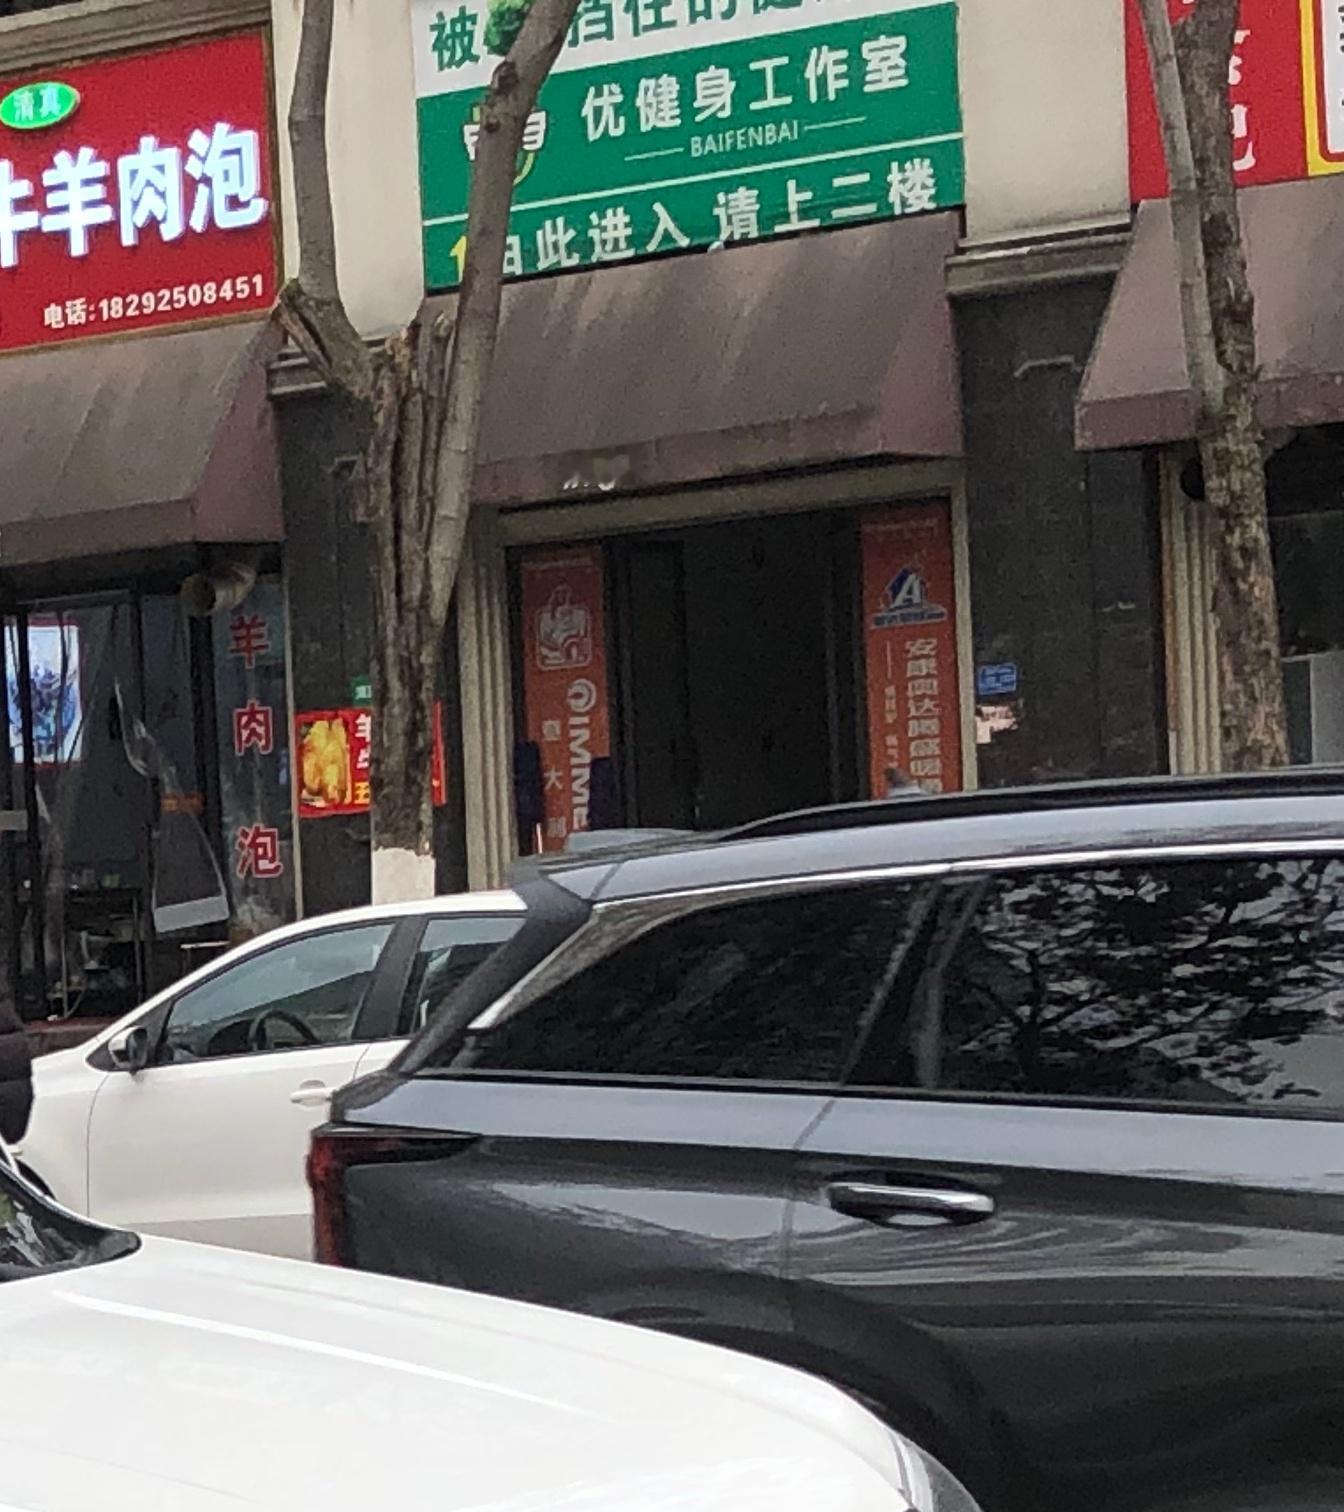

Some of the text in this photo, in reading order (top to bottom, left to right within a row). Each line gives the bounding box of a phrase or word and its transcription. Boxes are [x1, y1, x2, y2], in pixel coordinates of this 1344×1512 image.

[12, 85, 60, 121] 清真
[581, 34, 910, 142] 优健身工作室
[690, 119, 799, 158] BAIFENBAI
[713, 157, 937, 242] 请上二楼
[229, 614, 284, 880] 羊肉泡
